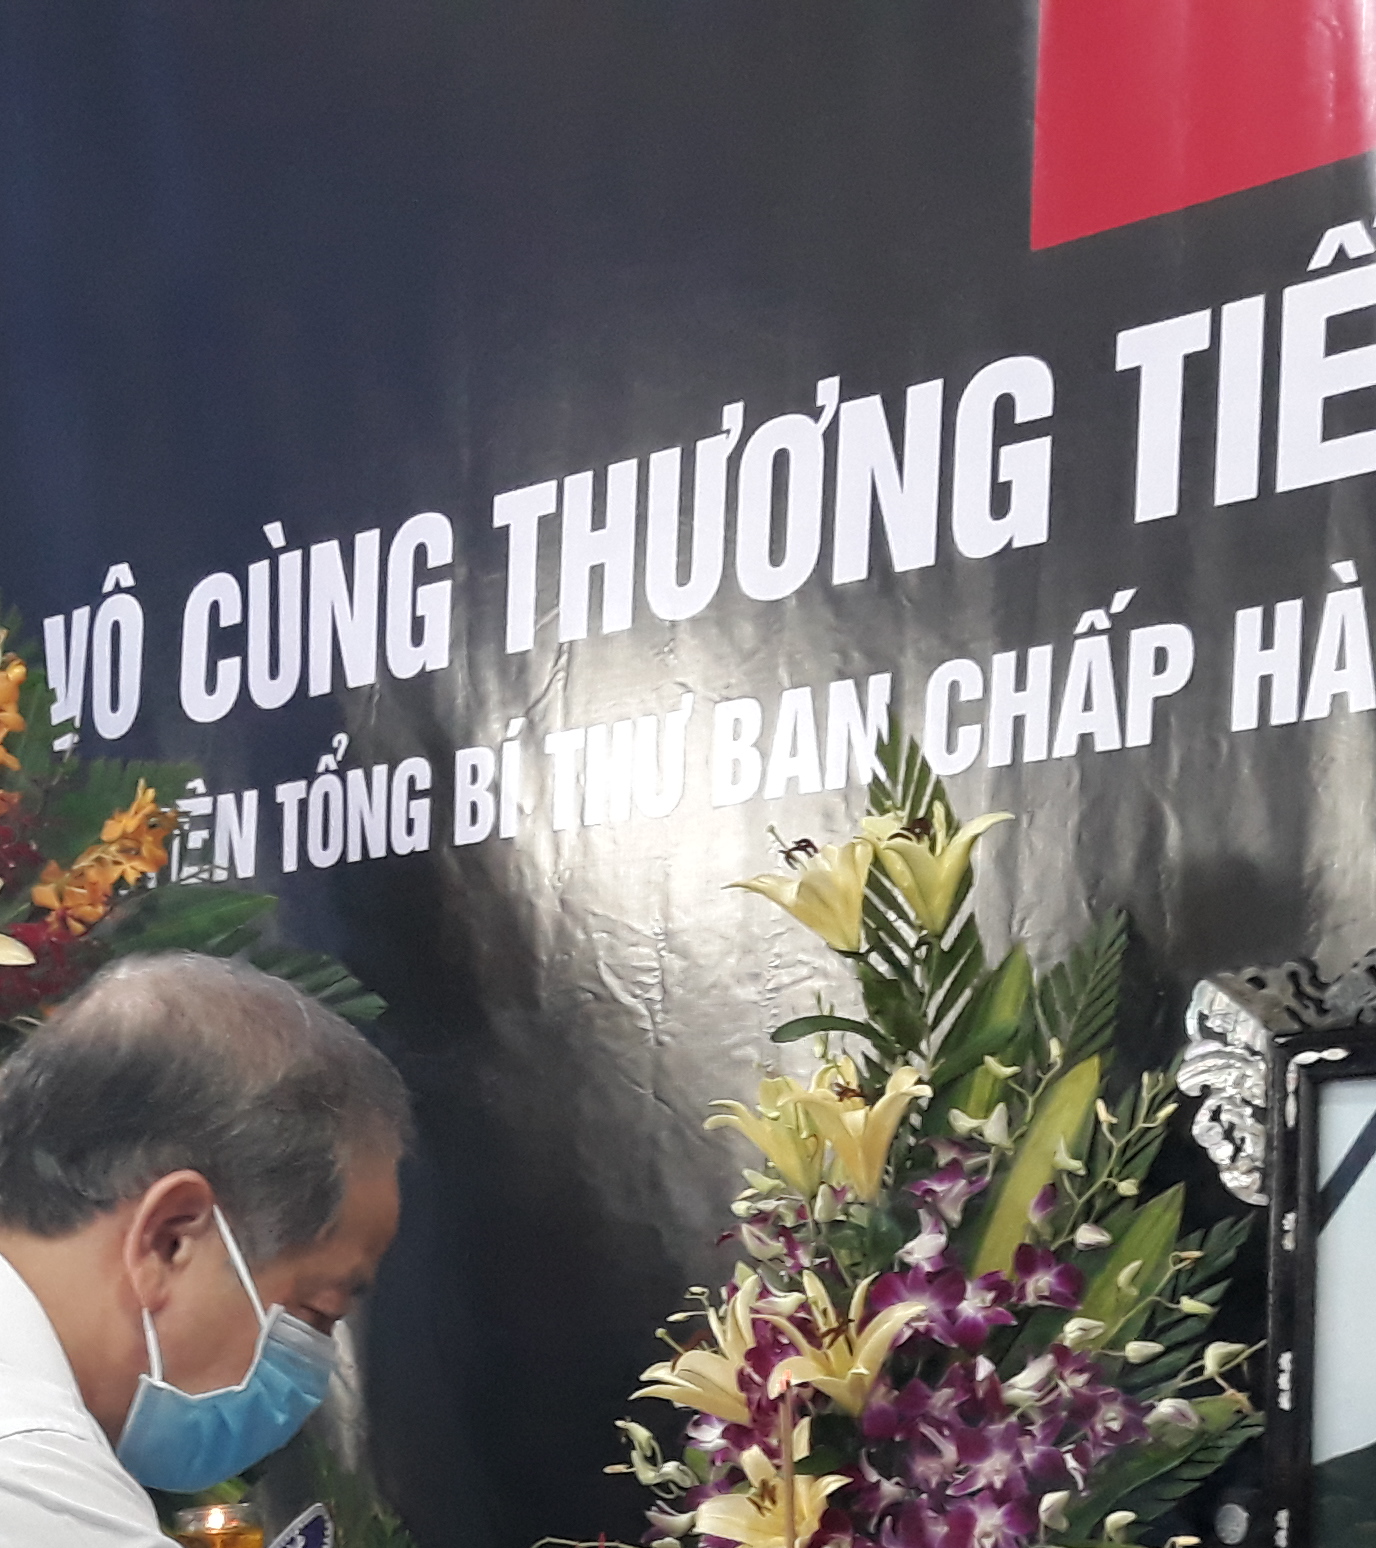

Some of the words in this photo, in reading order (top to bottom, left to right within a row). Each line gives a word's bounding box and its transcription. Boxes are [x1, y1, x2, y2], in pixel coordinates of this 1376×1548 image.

[43, 562, 144, 752] VÔ
[180, 512, 453, 723] CÙNG
[493, 355, 1055, 655] THƯƠNG
[276, 732, 432, 873] TỔNG
[454, 717, 527, 846] BÍ
[544, 691, 694, 831] THƯ
[713, 671, 893, 808] BAN
[926, 589, 1195, 777] CHẤP
